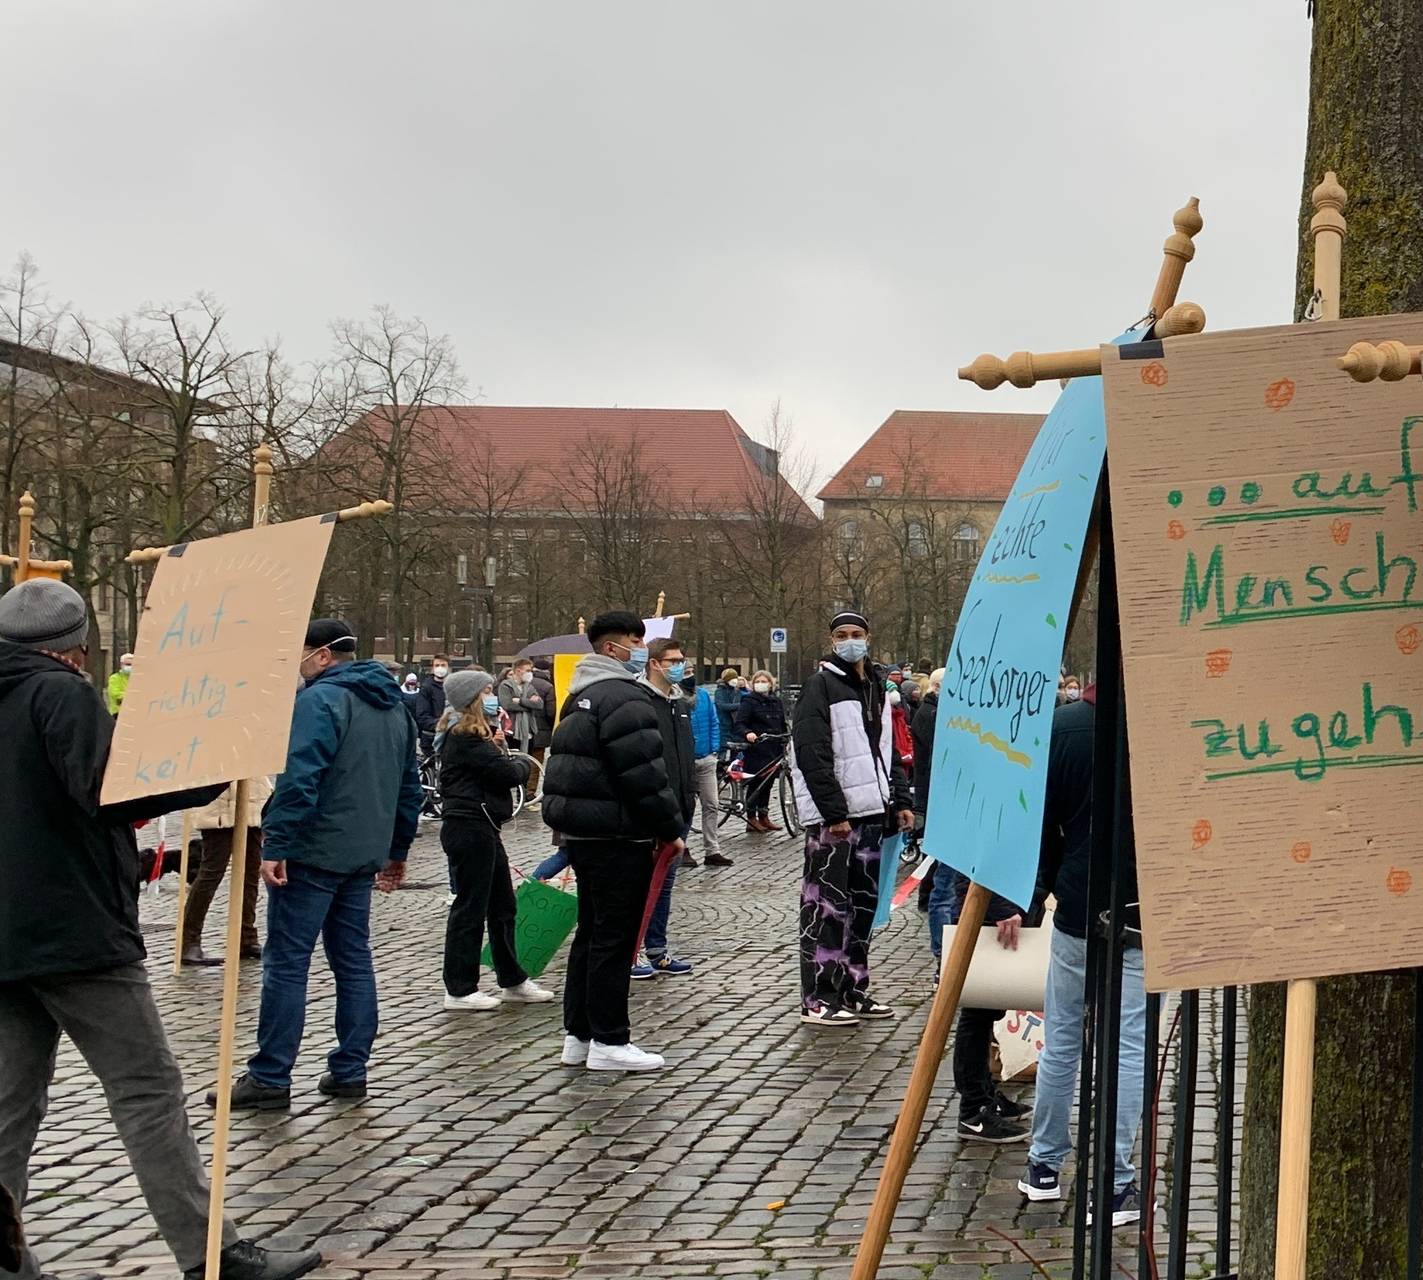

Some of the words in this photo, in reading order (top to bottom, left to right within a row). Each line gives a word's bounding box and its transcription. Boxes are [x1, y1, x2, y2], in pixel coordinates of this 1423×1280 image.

[991, 494, 1046, 564] echte
[948, 599, 1051, 744] Seelsorger
[135, 736, 202, 785] keit
